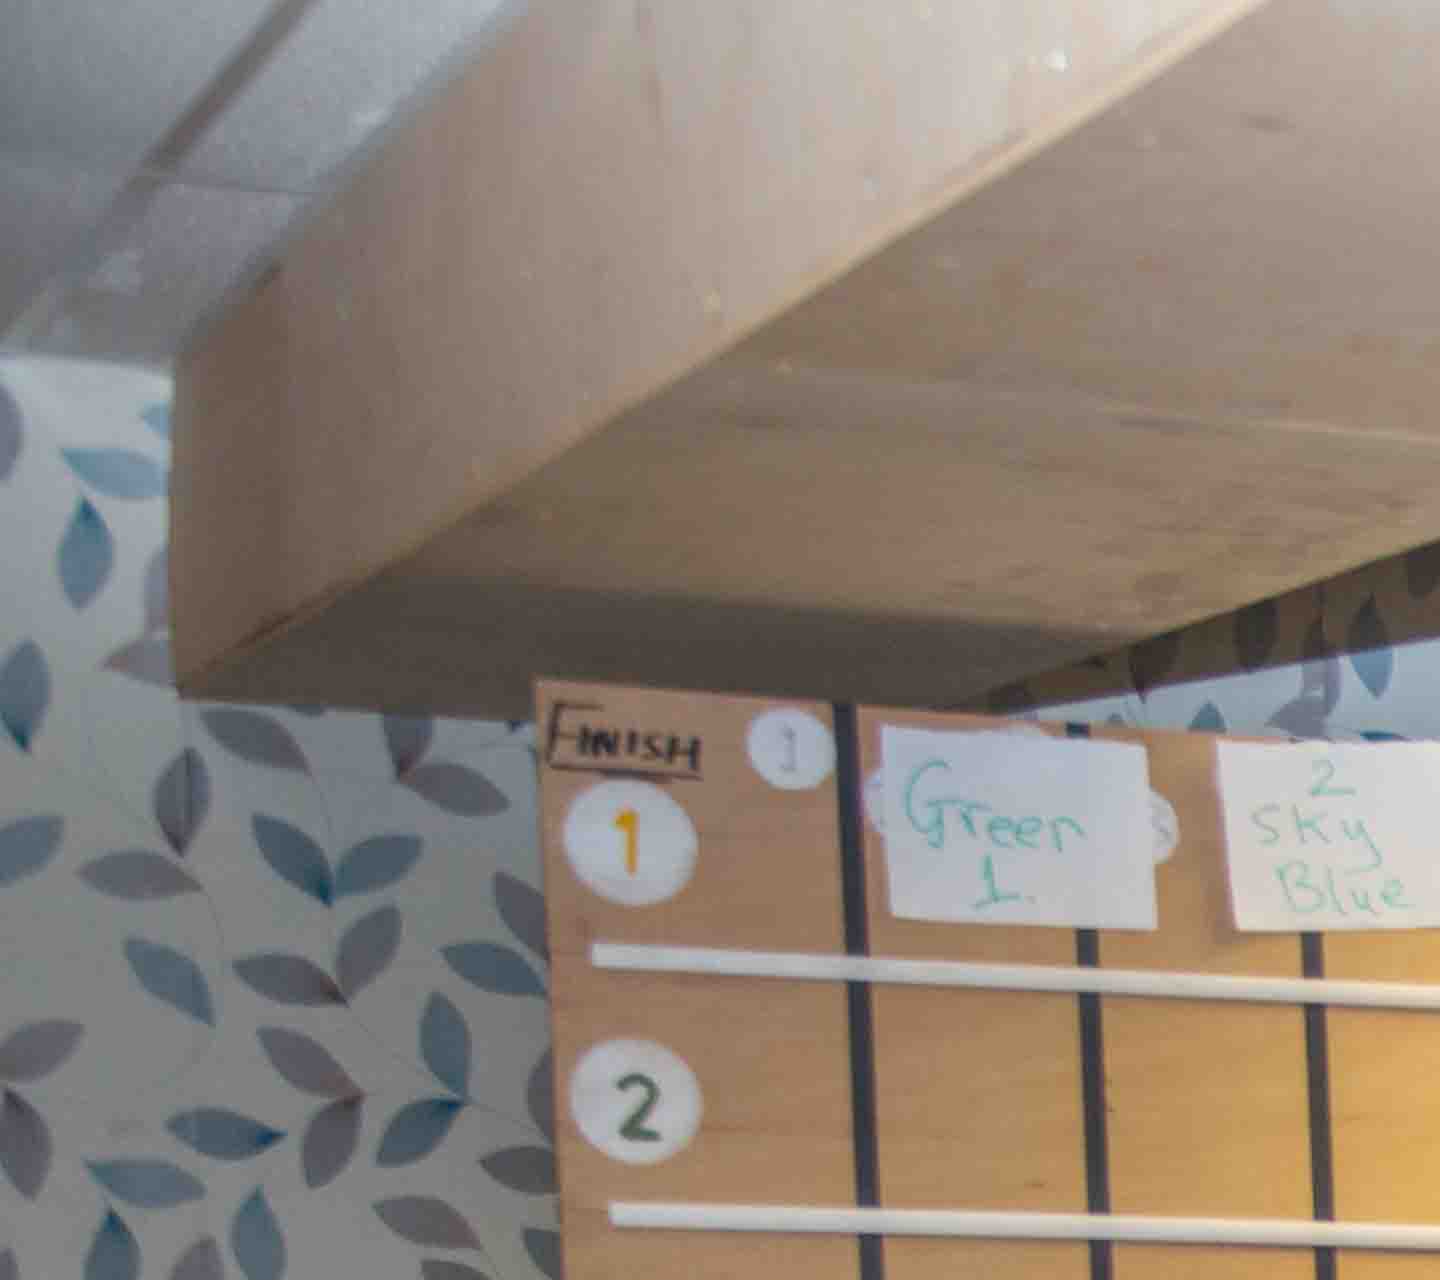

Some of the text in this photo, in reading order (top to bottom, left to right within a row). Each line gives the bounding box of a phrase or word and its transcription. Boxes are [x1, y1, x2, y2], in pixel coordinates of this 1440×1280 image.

[547, 702, 702, 774] FINISH
[905, 758, 1087, 853] Green
[1309, 759, 1356, 799] 2
[611, 806, 640, 879] 1
[1251, 804, 1384, 873] Sky
[1274, 861, 1410, 917] Blue
[614, 1073, 663, 1143] 2
